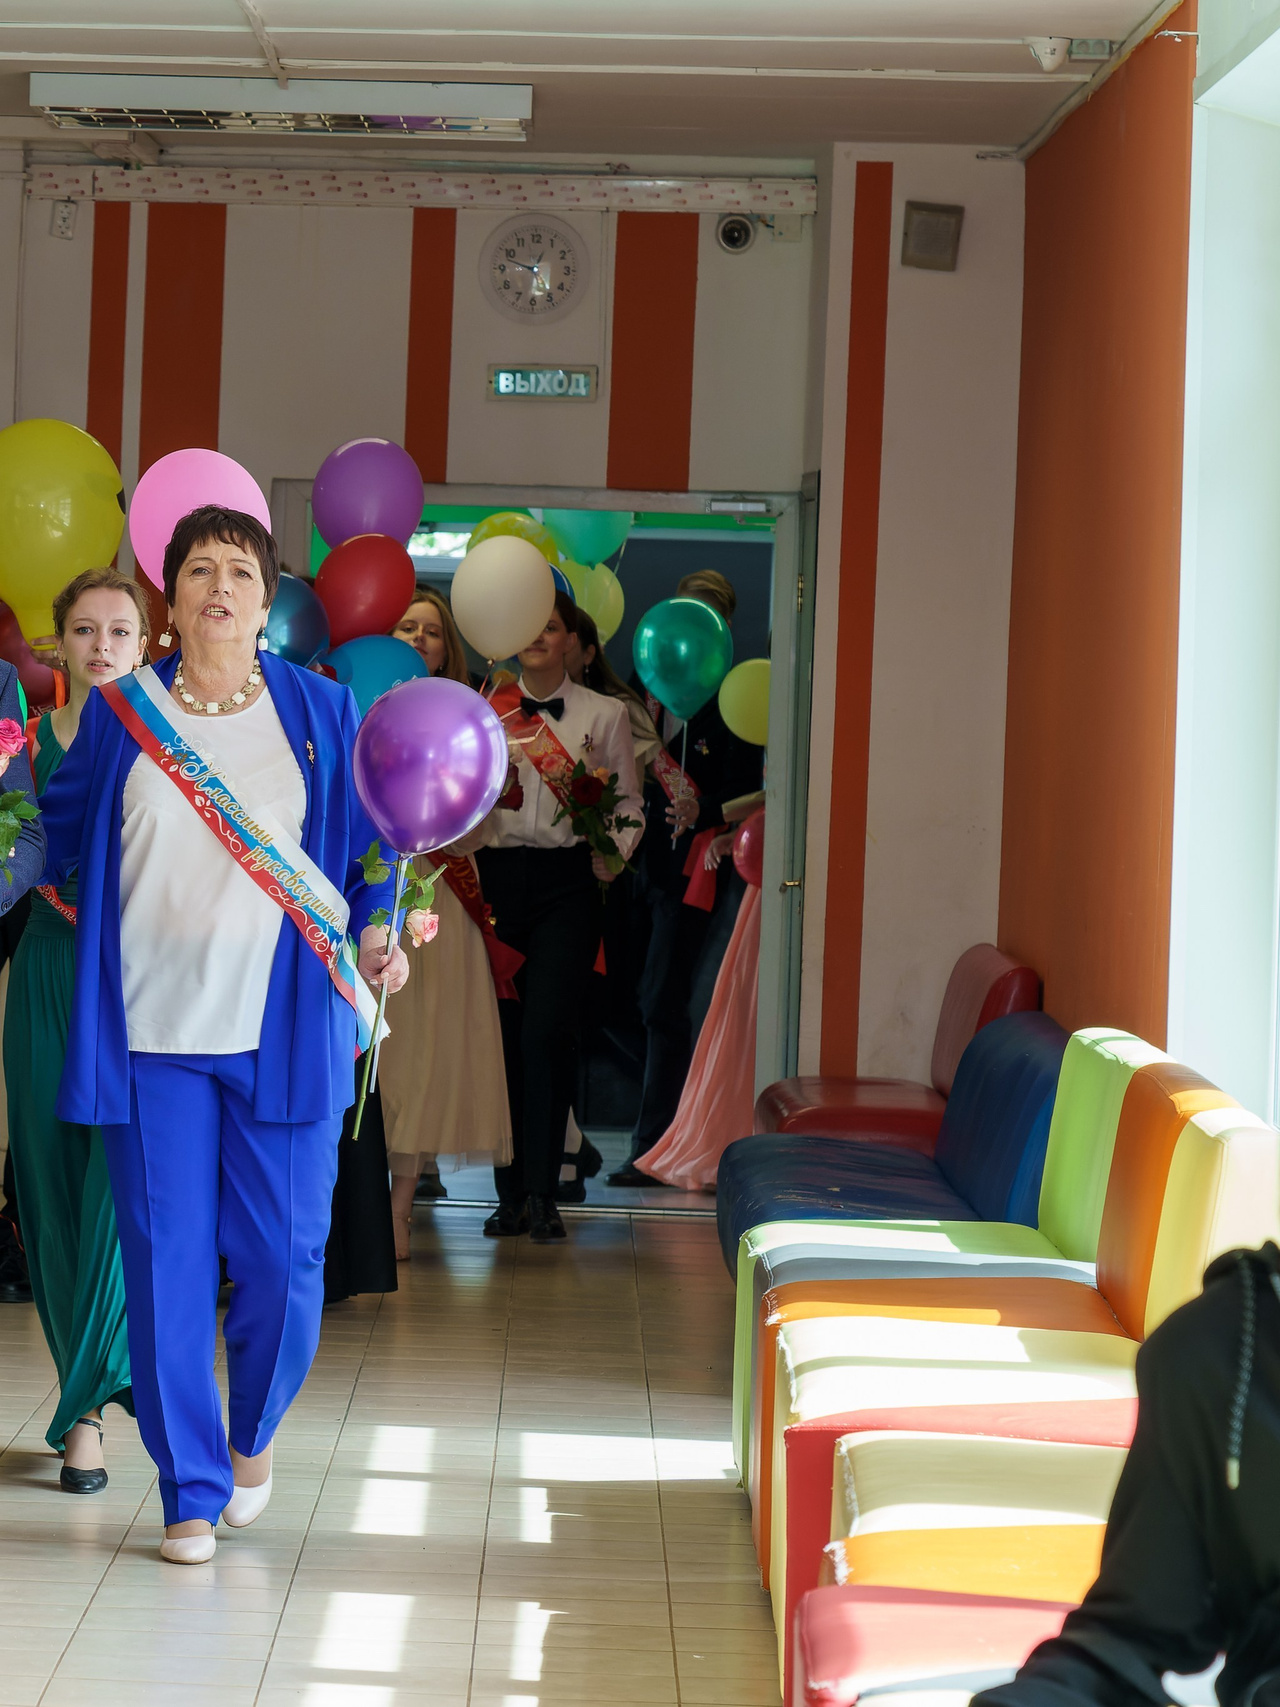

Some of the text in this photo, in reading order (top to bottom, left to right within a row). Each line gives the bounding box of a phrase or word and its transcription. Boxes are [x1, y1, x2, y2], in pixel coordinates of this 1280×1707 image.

[516, 238, 525, 247] 11
[531, 234, 543, 244] 12
[549, 239, 554, 249] 1
[505, 249, 516, 259] 10
[559, 250, 567, 260] 2
[498, 264, 506, 274] 9
[563, 266, 571, 276] 3
[503, 280, 511, 290] 8
[557, 283, 565, 291] 4
[515, 292, 523, 301] 7
[546, 293, 554, 303] 5
[529, 297, 537, 307] 6
[498, 371, 587, 396] ВЫХОД
